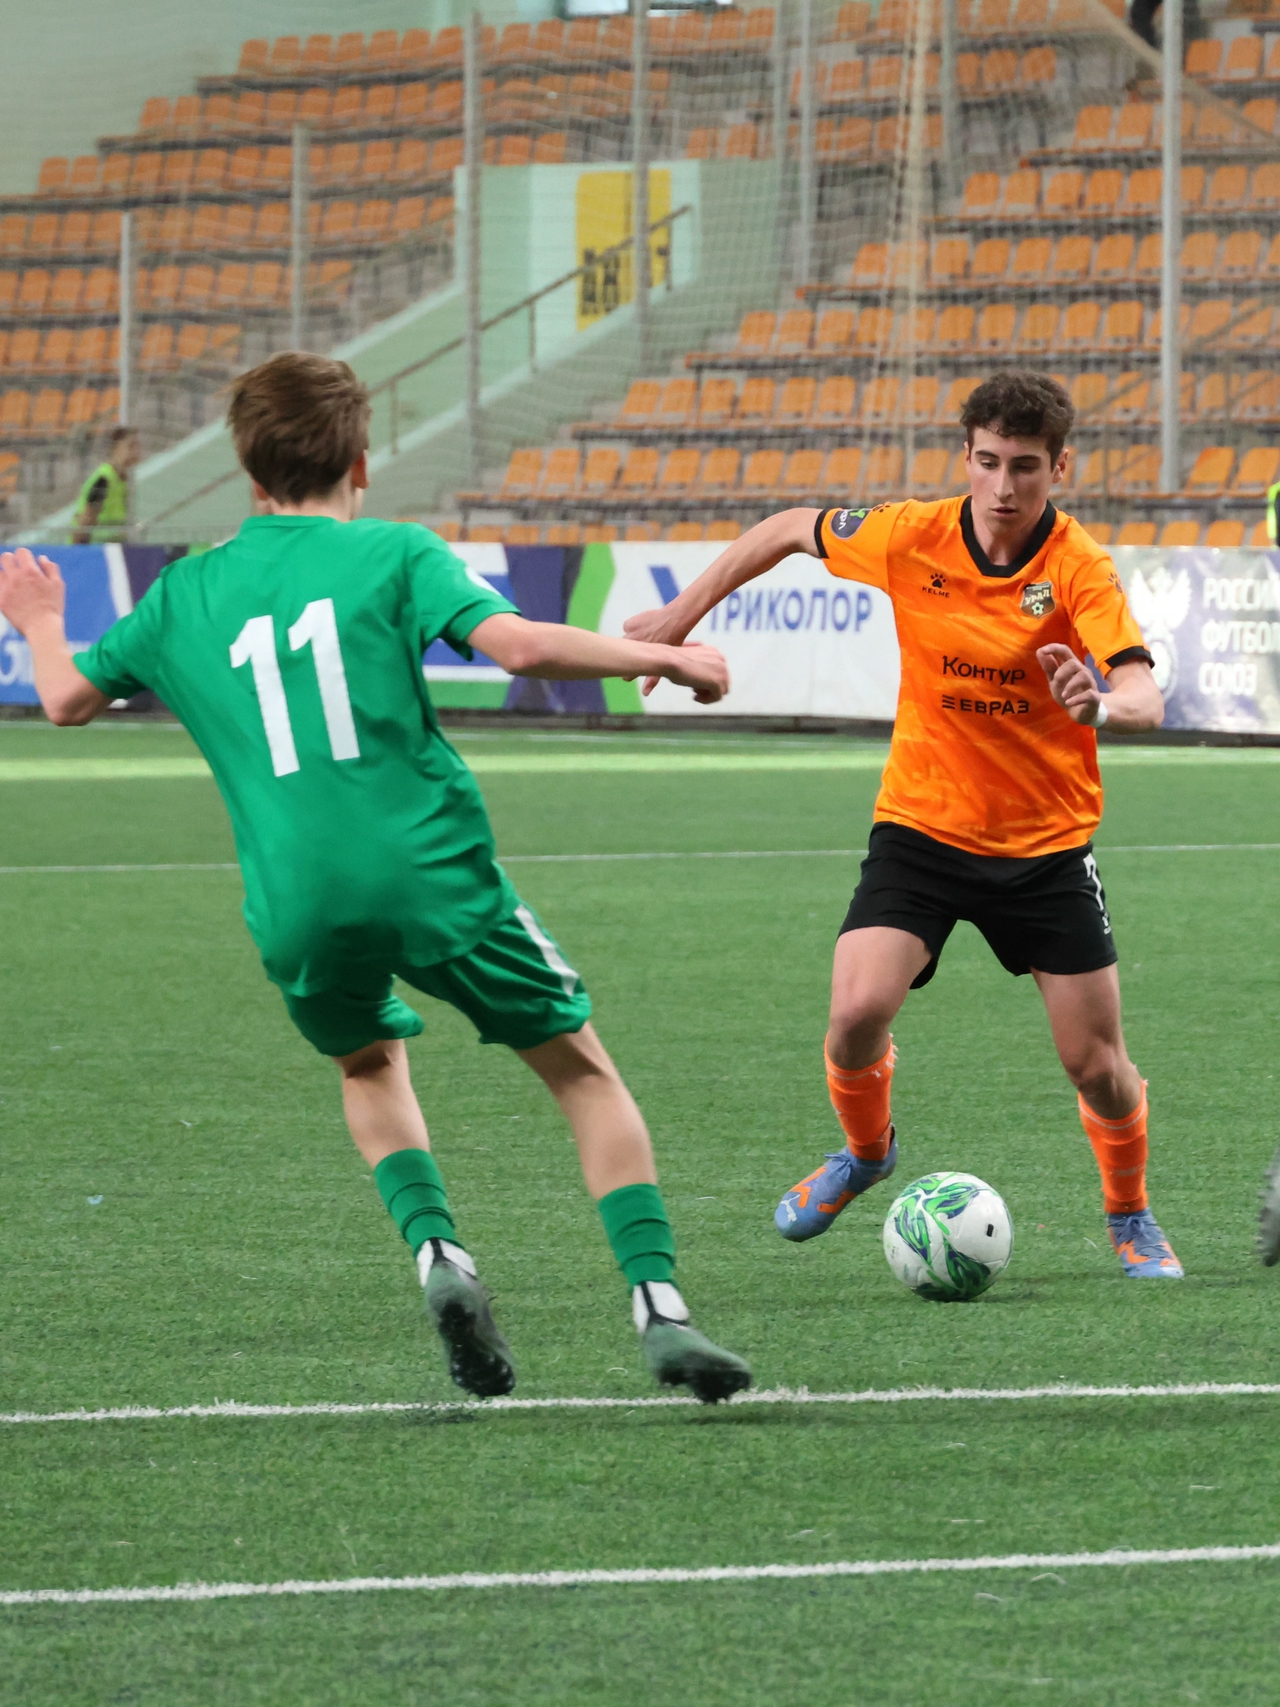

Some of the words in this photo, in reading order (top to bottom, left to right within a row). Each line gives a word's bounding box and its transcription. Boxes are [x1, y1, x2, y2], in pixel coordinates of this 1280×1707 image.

[922, 586, 950, 598] KELME
[942, 655, 1026, 685] Контур
[1199, 662, 1258, 695] СОЮЗ
[229, 598, 361, 777] 11
[960, 698, 1030, 716] ЕВРАЗ
[1083, 853, 1104, 911] 7
